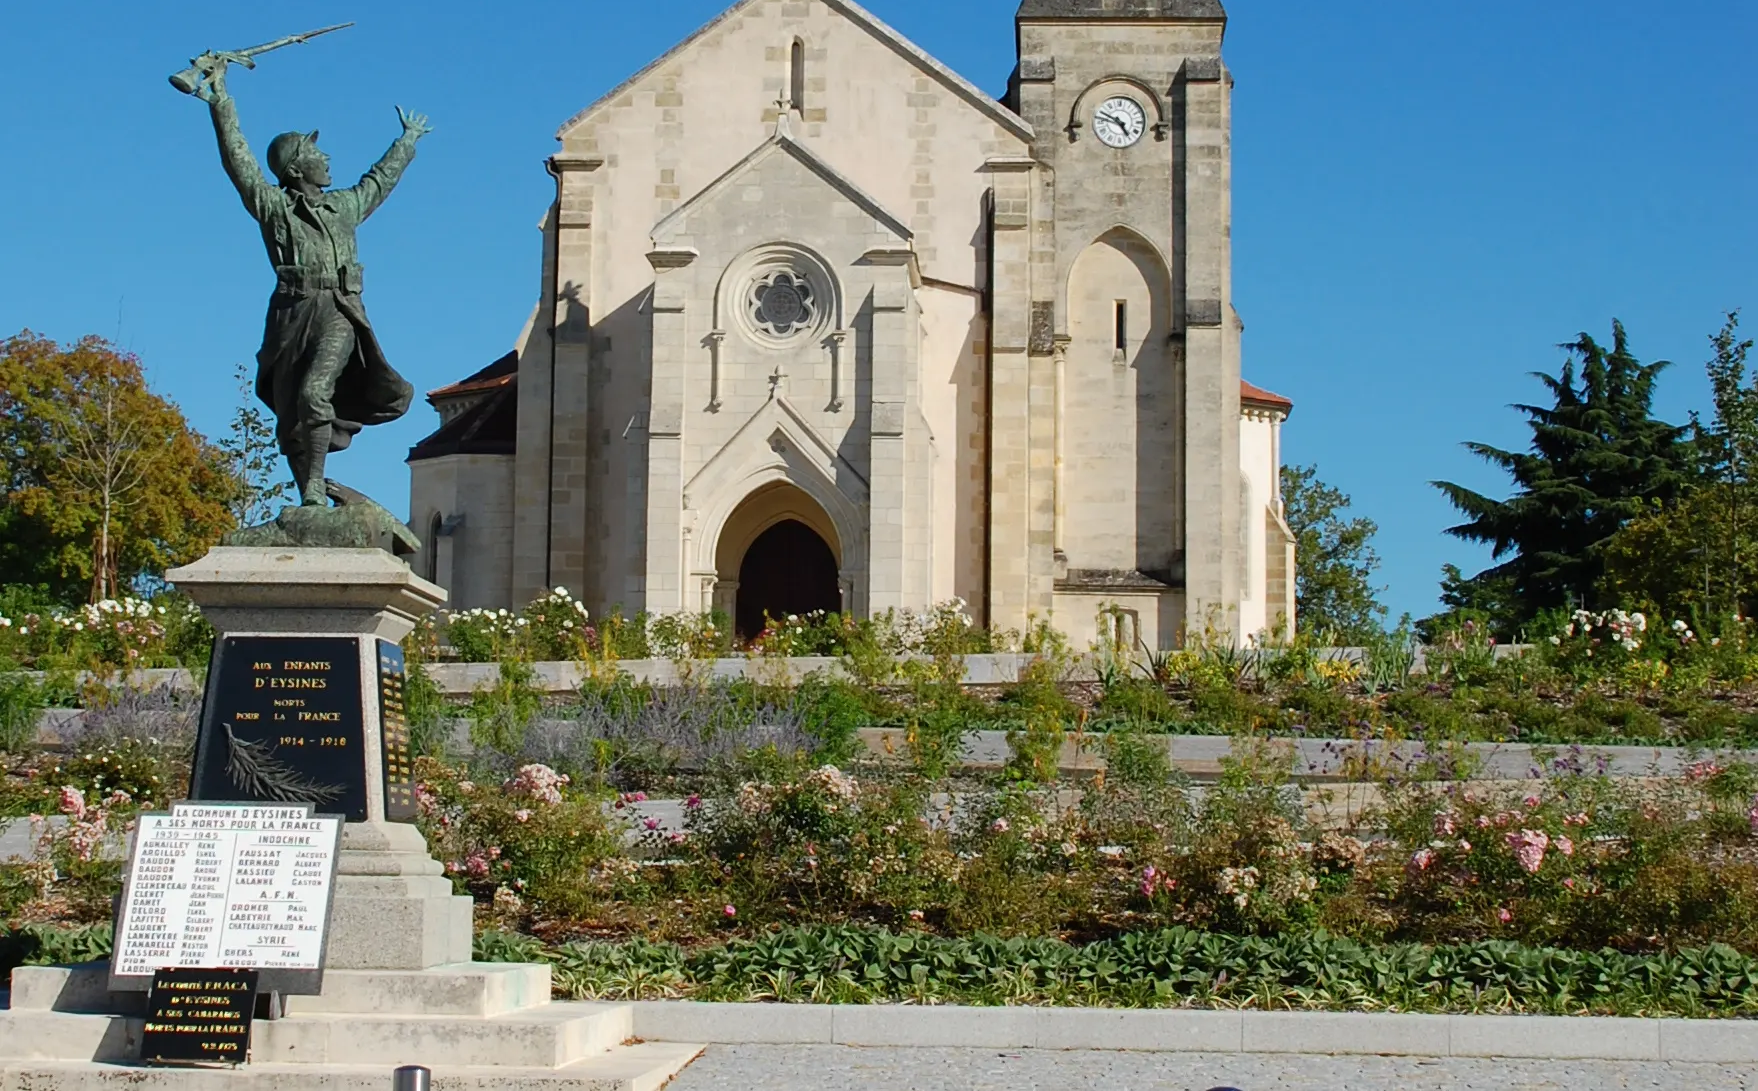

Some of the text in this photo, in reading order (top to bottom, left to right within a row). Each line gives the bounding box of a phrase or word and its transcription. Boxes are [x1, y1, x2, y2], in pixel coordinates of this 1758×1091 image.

[284, 661, 331, 670] ENFANTS
[255, 677, 327, 688] D'EYSINES
[274, 699, 305, 707] MORTS
[236, 712, 260, 720] POUR
[299, 712, 341, 721] FRANCE
[280, 737, 304, 746] 1914
[320, 737, 346, 746] 1918
[177, 809, 302, 819] LA COMMUNE D'EYSINES
[231, 821, 256, 829] POUR
[263, 821, 274, 829] LA
[281, 822, 322, 830] FRANCE
[259, 836, 310, 844] INDOCHINE
[257, 936, 286, 944] SYRIE
